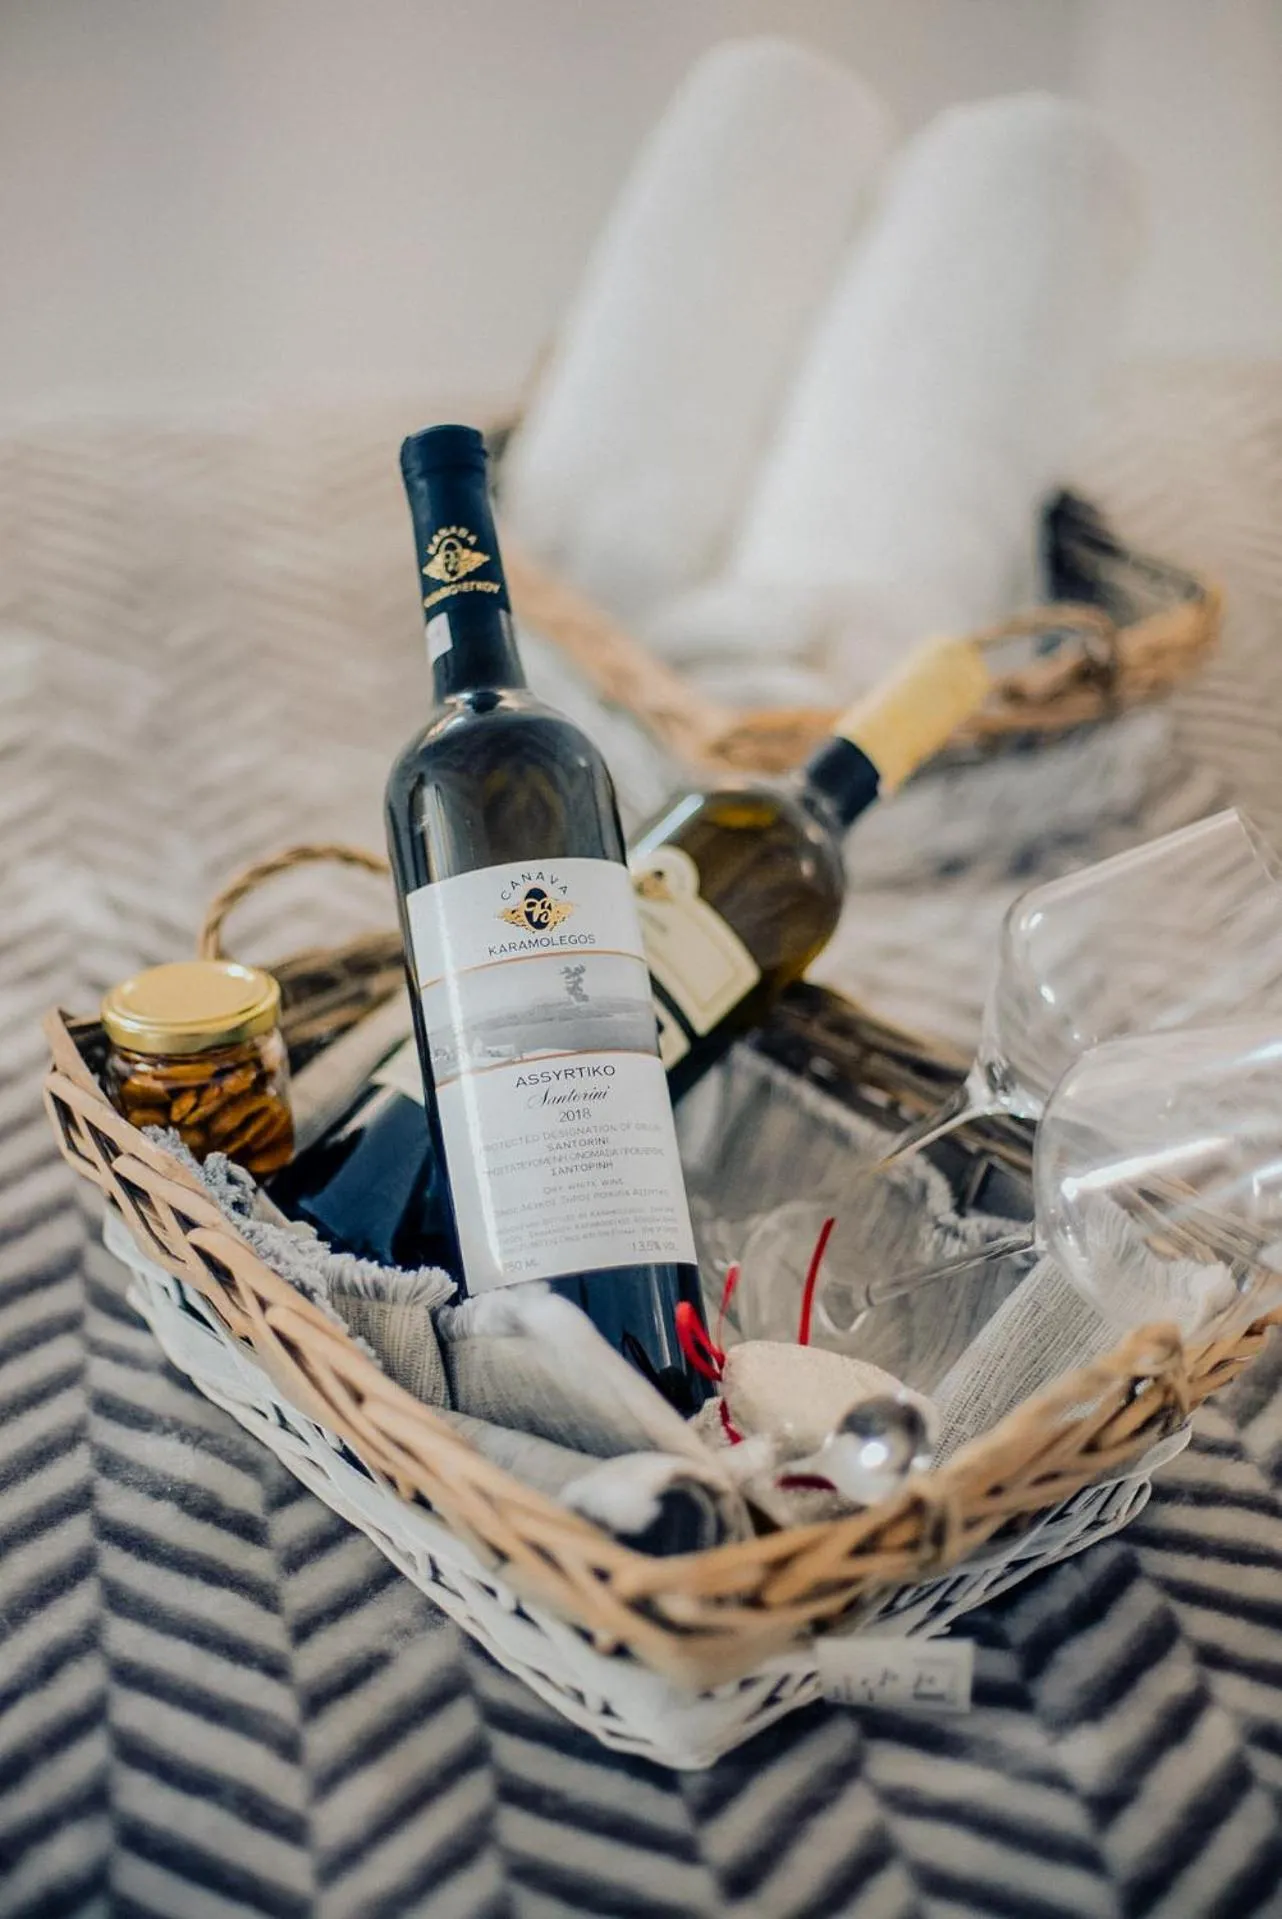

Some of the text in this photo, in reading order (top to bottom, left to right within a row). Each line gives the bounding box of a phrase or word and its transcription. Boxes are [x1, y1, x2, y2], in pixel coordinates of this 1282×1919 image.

[500, 870, 569, 901] CANAVA
[488, 934, 597, 957] KARAMOLEGOS
[515, 1064, 616, 1088] ASSYRTIKO
[527, 1084, 611, 1110] Santorini
[558, 1108, 592, 1123] 2018
[547, 1135, 609, 1152] SANTORINI
